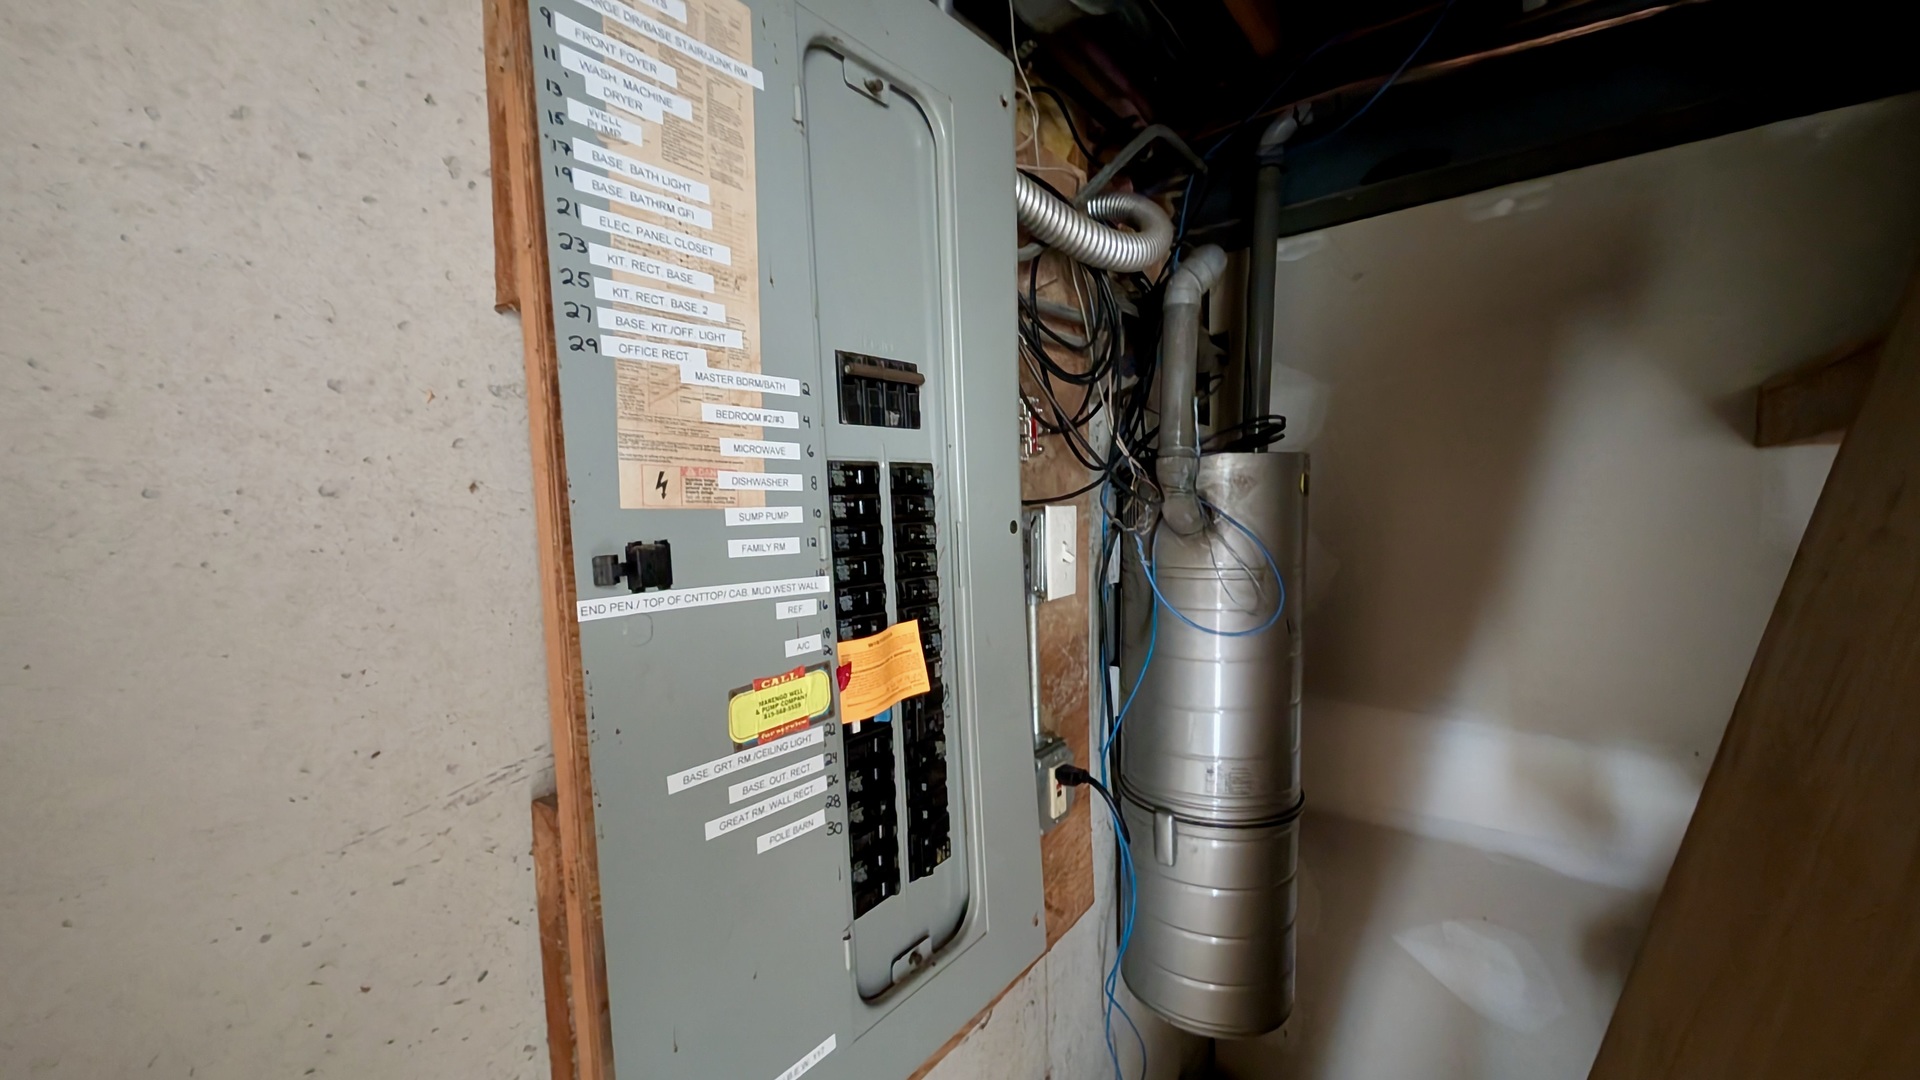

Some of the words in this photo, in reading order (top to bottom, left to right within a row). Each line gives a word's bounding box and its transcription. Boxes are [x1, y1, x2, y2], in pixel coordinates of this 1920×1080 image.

[539, 6, 551, 28] 9
[543, 45, 556, 61] 11
[574, 27, 617, 55] FRONT
[619, 47, 658, 75] FOYER
[733, 64, 748, 78] RM
[546, 78, 563, 97] 13
[622, 78, 673, 109] MACHINE
[603, 86, 643, 112] DRYER
[547, 109, 566, 126] 15
[588, 107, 622, 129] WELL
[552, 139, 573, 156] 17
[554, 165, 573, 183] 19
[629, 163, 660, 183] BATH
[661, 175, 692, 193] LIGHT
[556, 197, 580, 219] 21
[629, 190, 676, 214] BATHRM
[677, 206, 695, 220] GFI
[557, 232, 588, 253] 23
[599, 215, 633, 235] ELEC.
[635, 226, 672, 246] PANEL
[673, 236, 714, 257] CLOSET
[607, 253, 627, 267] KIT.
[560, 267, 590, 288] 25
[612, 287, 632, 300] KIT.
[702, 305, 709, 316] 2
[564, 301, 592, 323] 27
[568, 335, 598, 354] 29
[698, 330, 726, 343] LIGHT
[618, 342, 659, 358] OFFICE
[694, 371, 734, 385] MASTER
[735, 376, 786, 391] BDRM/BATH
[802, 382, 811, 395] 2
[715, 409, 762, 422] BEDROOM
[803, 415, 811, 428] 4
[733, 443, 786, 456] MICROWAVE
[806, 445, 815, 458] 6
[731, 476, 789, 488] DISHWASHER
[810, 476, 818, 490] 8
[738, 511, 764, 522] SUMP
[765, 511, 790, 521] PUMP
[812, 508, 822, 519] 10
[741, 543, 772, 553] FAMILY
[773, 542, 786, 551] RM
[806, 537, 817, 547] 12
[580, 603, 607, 617] END
[642, 597, 665, 608] TOP
[666, 595, 682, 606] OF
[683, 590, 727, 604] CNTTOP/
[751, 585, 772, 596] MUD
[772, 582, 797, 594] WEST
[797, 581, 819, 591] WALL
[819, 600, 829, 611] 16
[787, 604, 803, 614] REF
[796, 640, 810, 651] A/C
[761, 672, 799, 689] CALL
[758, 694, 787, 707] MARENGO
[789, 688, 803, 699] WELL
[761, 703, 780, 713] PUMP
[780, 693, 808, 707] COMPANY
[761, 730, 775, 741] for
[789, 733, 812, 749] LIGHT
[825, 794, 841, 808] 28
[718, 810, 750, 831] GREAT
[768, 795, 792, 811] WALL
[769, 828, 791, 845] POLE
[792, 818, 814, 835] BARN
[826, 823, 843, 836] 30
